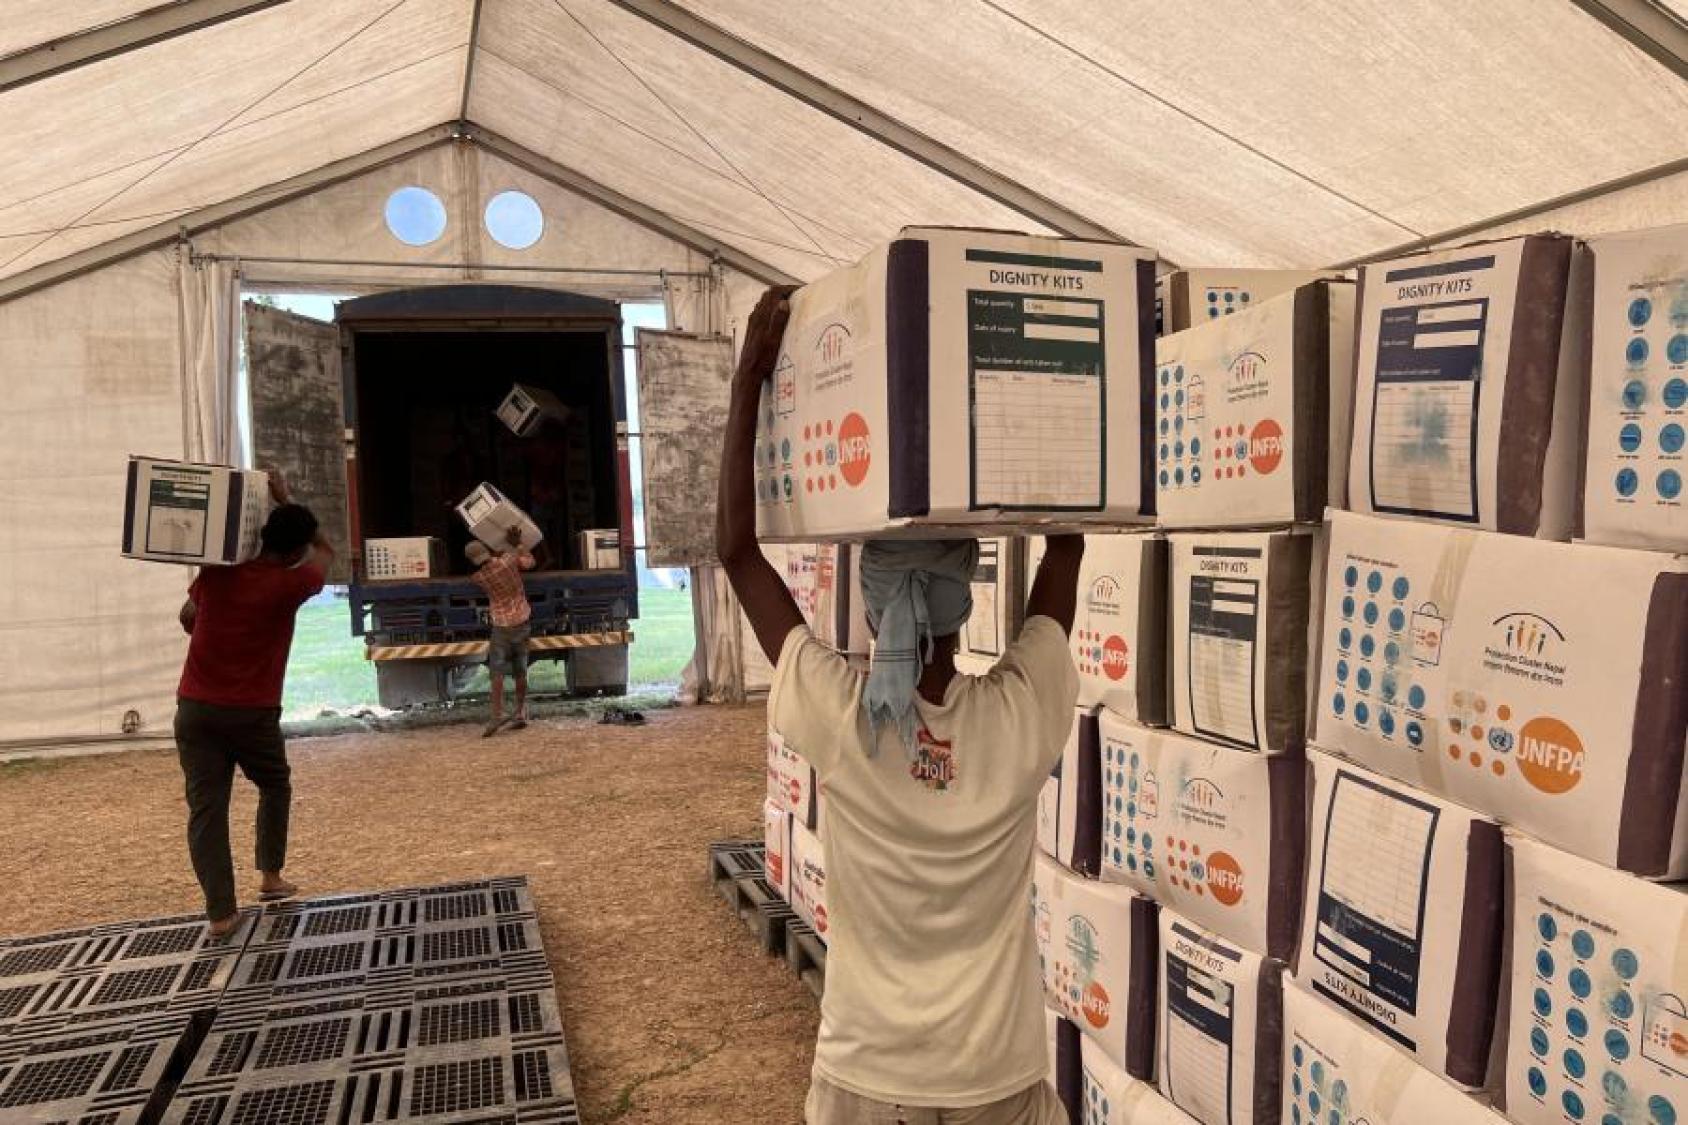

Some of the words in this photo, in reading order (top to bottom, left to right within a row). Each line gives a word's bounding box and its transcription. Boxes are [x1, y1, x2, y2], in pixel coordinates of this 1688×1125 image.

[989, 269, 1048, 286] DIGNITY
[1053, 275, 1083, 290] KITS
[1397, 281, 1444, 301] DIGNITY
[1446, 277, 1473, 295] KITS
[1200, 559, 1229, 573] DIGNITY
[1230, 561, 1248, 574] KITS
[1516, 735, 1585, 776] UNFPA
[1205, 865, 1244, 893] UNFPA
[1175, 940, 1206, 963] DIGNITY
[1206, 955, 1224, 972] KITS
[1324, 971, 1348, 995] KITS
[1350, 988, 1397, 1025] DIGNITY
